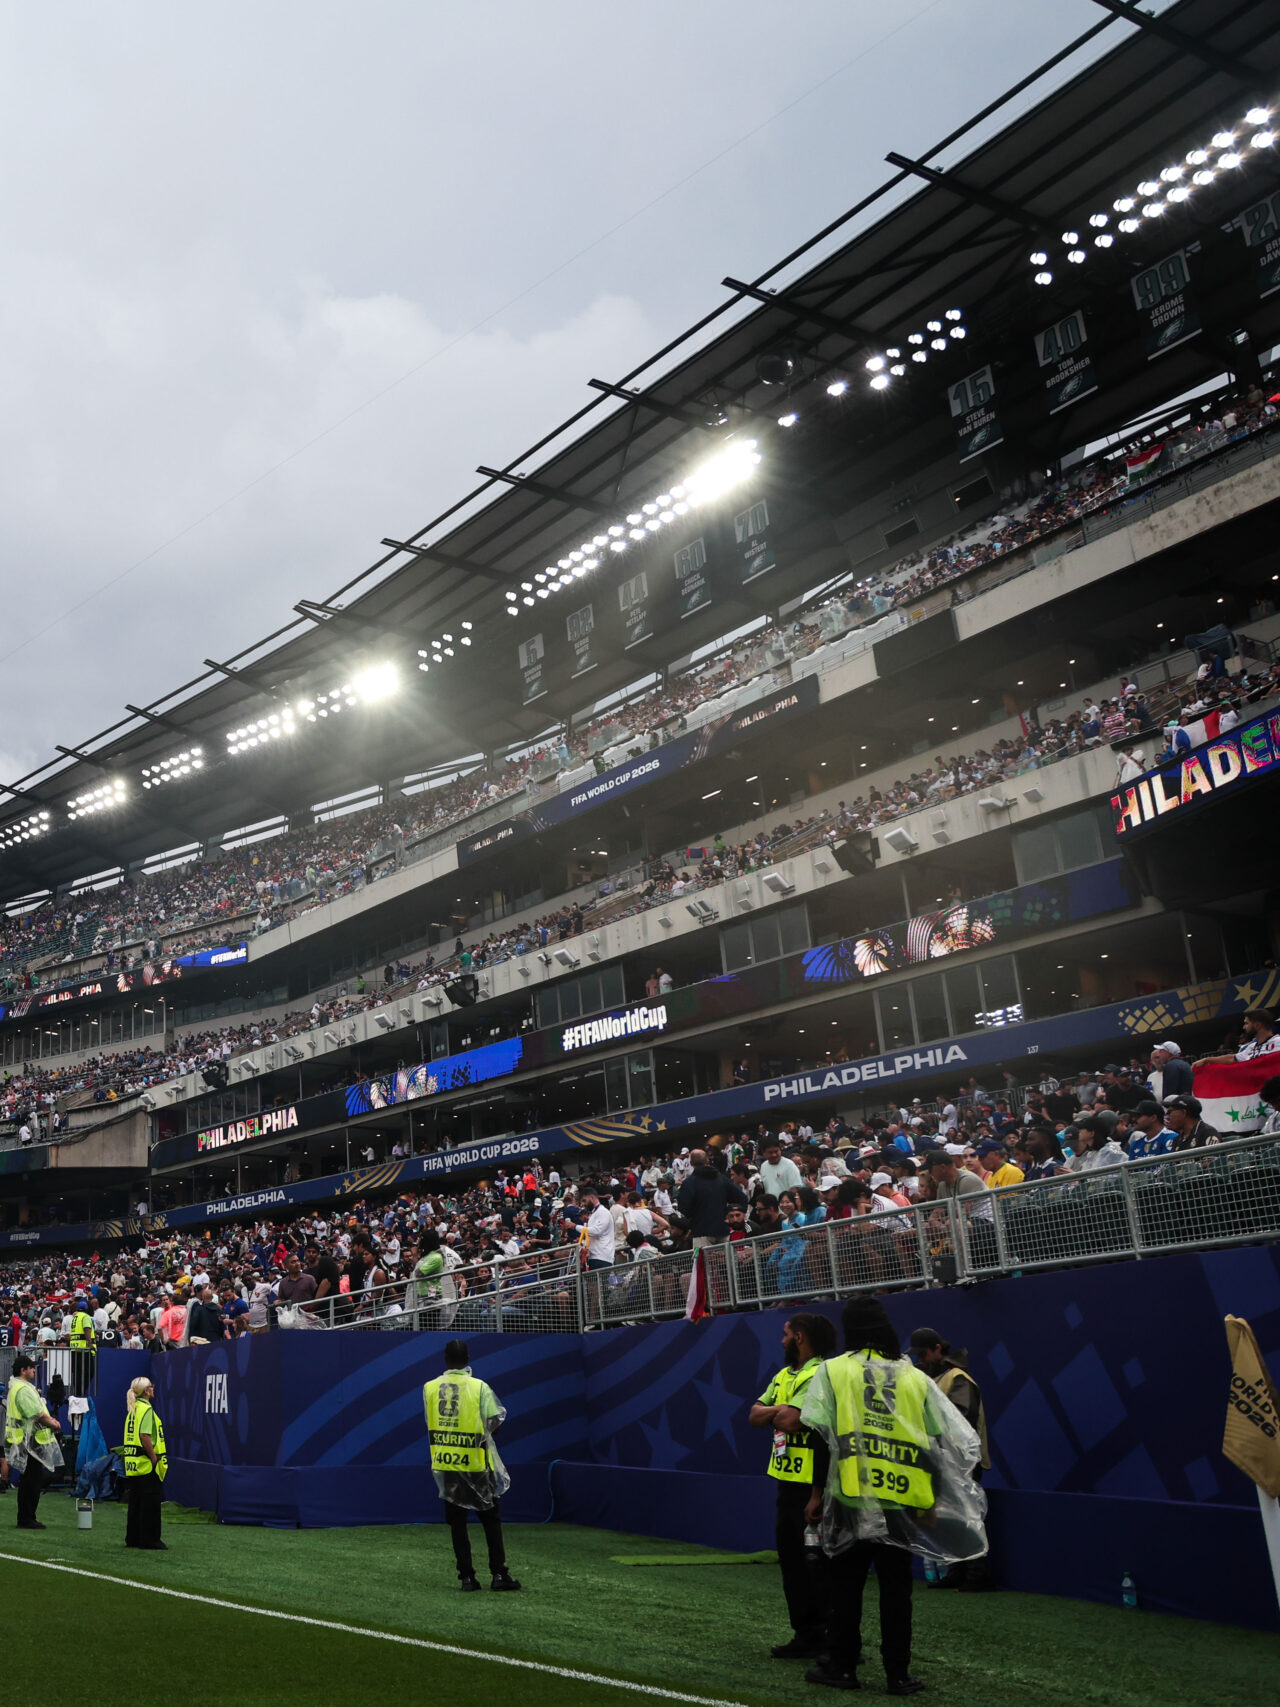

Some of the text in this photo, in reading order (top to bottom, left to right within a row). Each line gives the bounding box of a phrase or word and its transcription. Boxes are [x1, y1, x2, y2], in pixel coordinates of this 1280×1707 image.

[1136, 255, 1186, 309] 99
[1149, 294, 1184, 320] JEROME
[1151, 304, 1185, 328] BROWN
[1042, 314, 1082, 362] 40
[1045, 357, 1091, 389] BROOKSHIER
[1057, 357, 1074, 372] TOM
[951, 371, 993, 417] 15
[958, 411, 996, 437] VAN BUREN
[965, 408, 985, 425] STEVE
[736, 502, 769, 543] 70
[676, 539, 706, 578] 60
[621, 574, 646, 610] 44
[525, 638, 538, 666] 5
[732, 695, 799, 732] HILADPHIA
[571, 759, 660, 807] FIFA WORLD CUP 2026
[39, 983, 102, 1006] HILADPHIA
[562, 1005, 668, 1051] #FIFAWorldCup
[763, 1045, 967, 1101] PHILADELPHIA
[197, 1106, 299, 1152] PHILADELPHIA
[423, 1137, 540, 1172] FIFA WORLD CUP 2026
[206, 1190, 286, 1215] PHILADELPHIA
[1, 1333, 9, 1346] 3
[102, 1330, 115, 1340] 10
[205, 1374, 228, 1414] FIFA
[1231, 1373, 1273, 1414] ORLD
[433, 1432, 475, 1446] SCURITY
[864, 1418, 894, 1431] 2026
[849, 1436, 919, 1463] SCURITY
